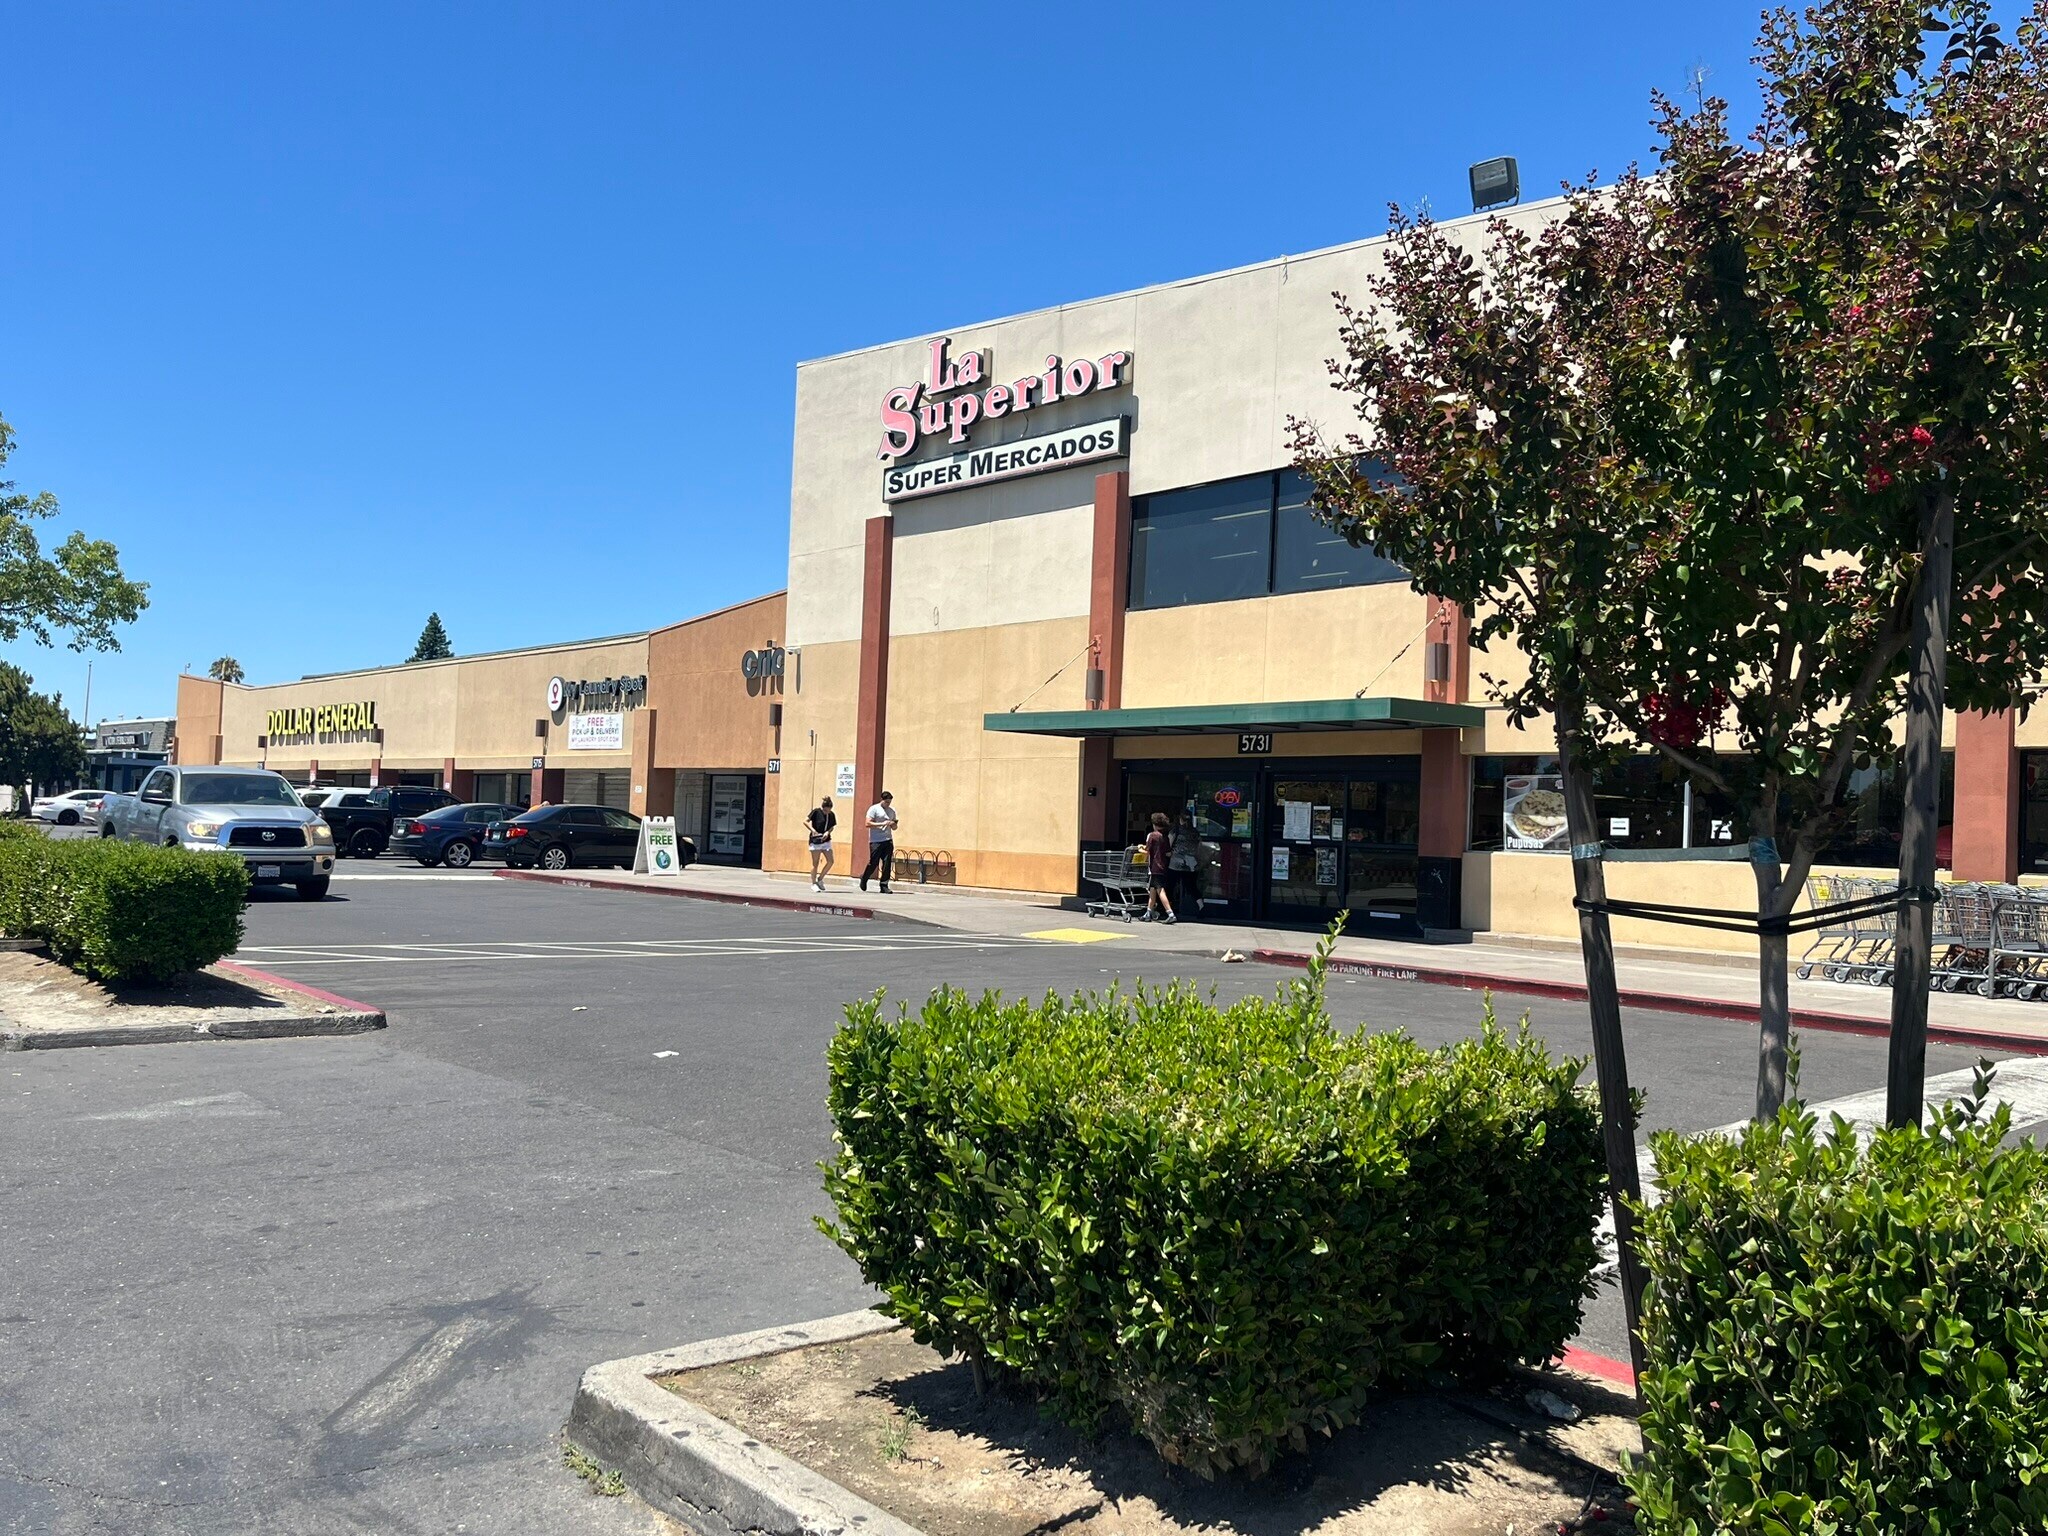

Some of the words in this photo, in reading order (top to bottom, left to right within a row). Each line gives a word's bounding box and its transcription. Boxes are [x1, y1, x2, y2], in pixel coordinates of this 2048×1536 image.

[926, 337, 984, 396] La
[877, 351, 1129, 460] Superior
[579, 677, 618, 697] Laundry
[620, 675, 646, 696] Spot
[267, 707, 313, 736] DOLLAR
[315, 701, 375, 733] GENERAL
[587, 716, 604, 727] FREE
[1242, 734, 1270, 751] 5731
[1215, 791, 1240, 803] OPEN
[650, 835, 673, 845] FREE
[1507, 836, 1544, 849] Pupusas
[1340, 964, 1373, 976] PARKING
[1377, 968, 1395, 978] FIRE
